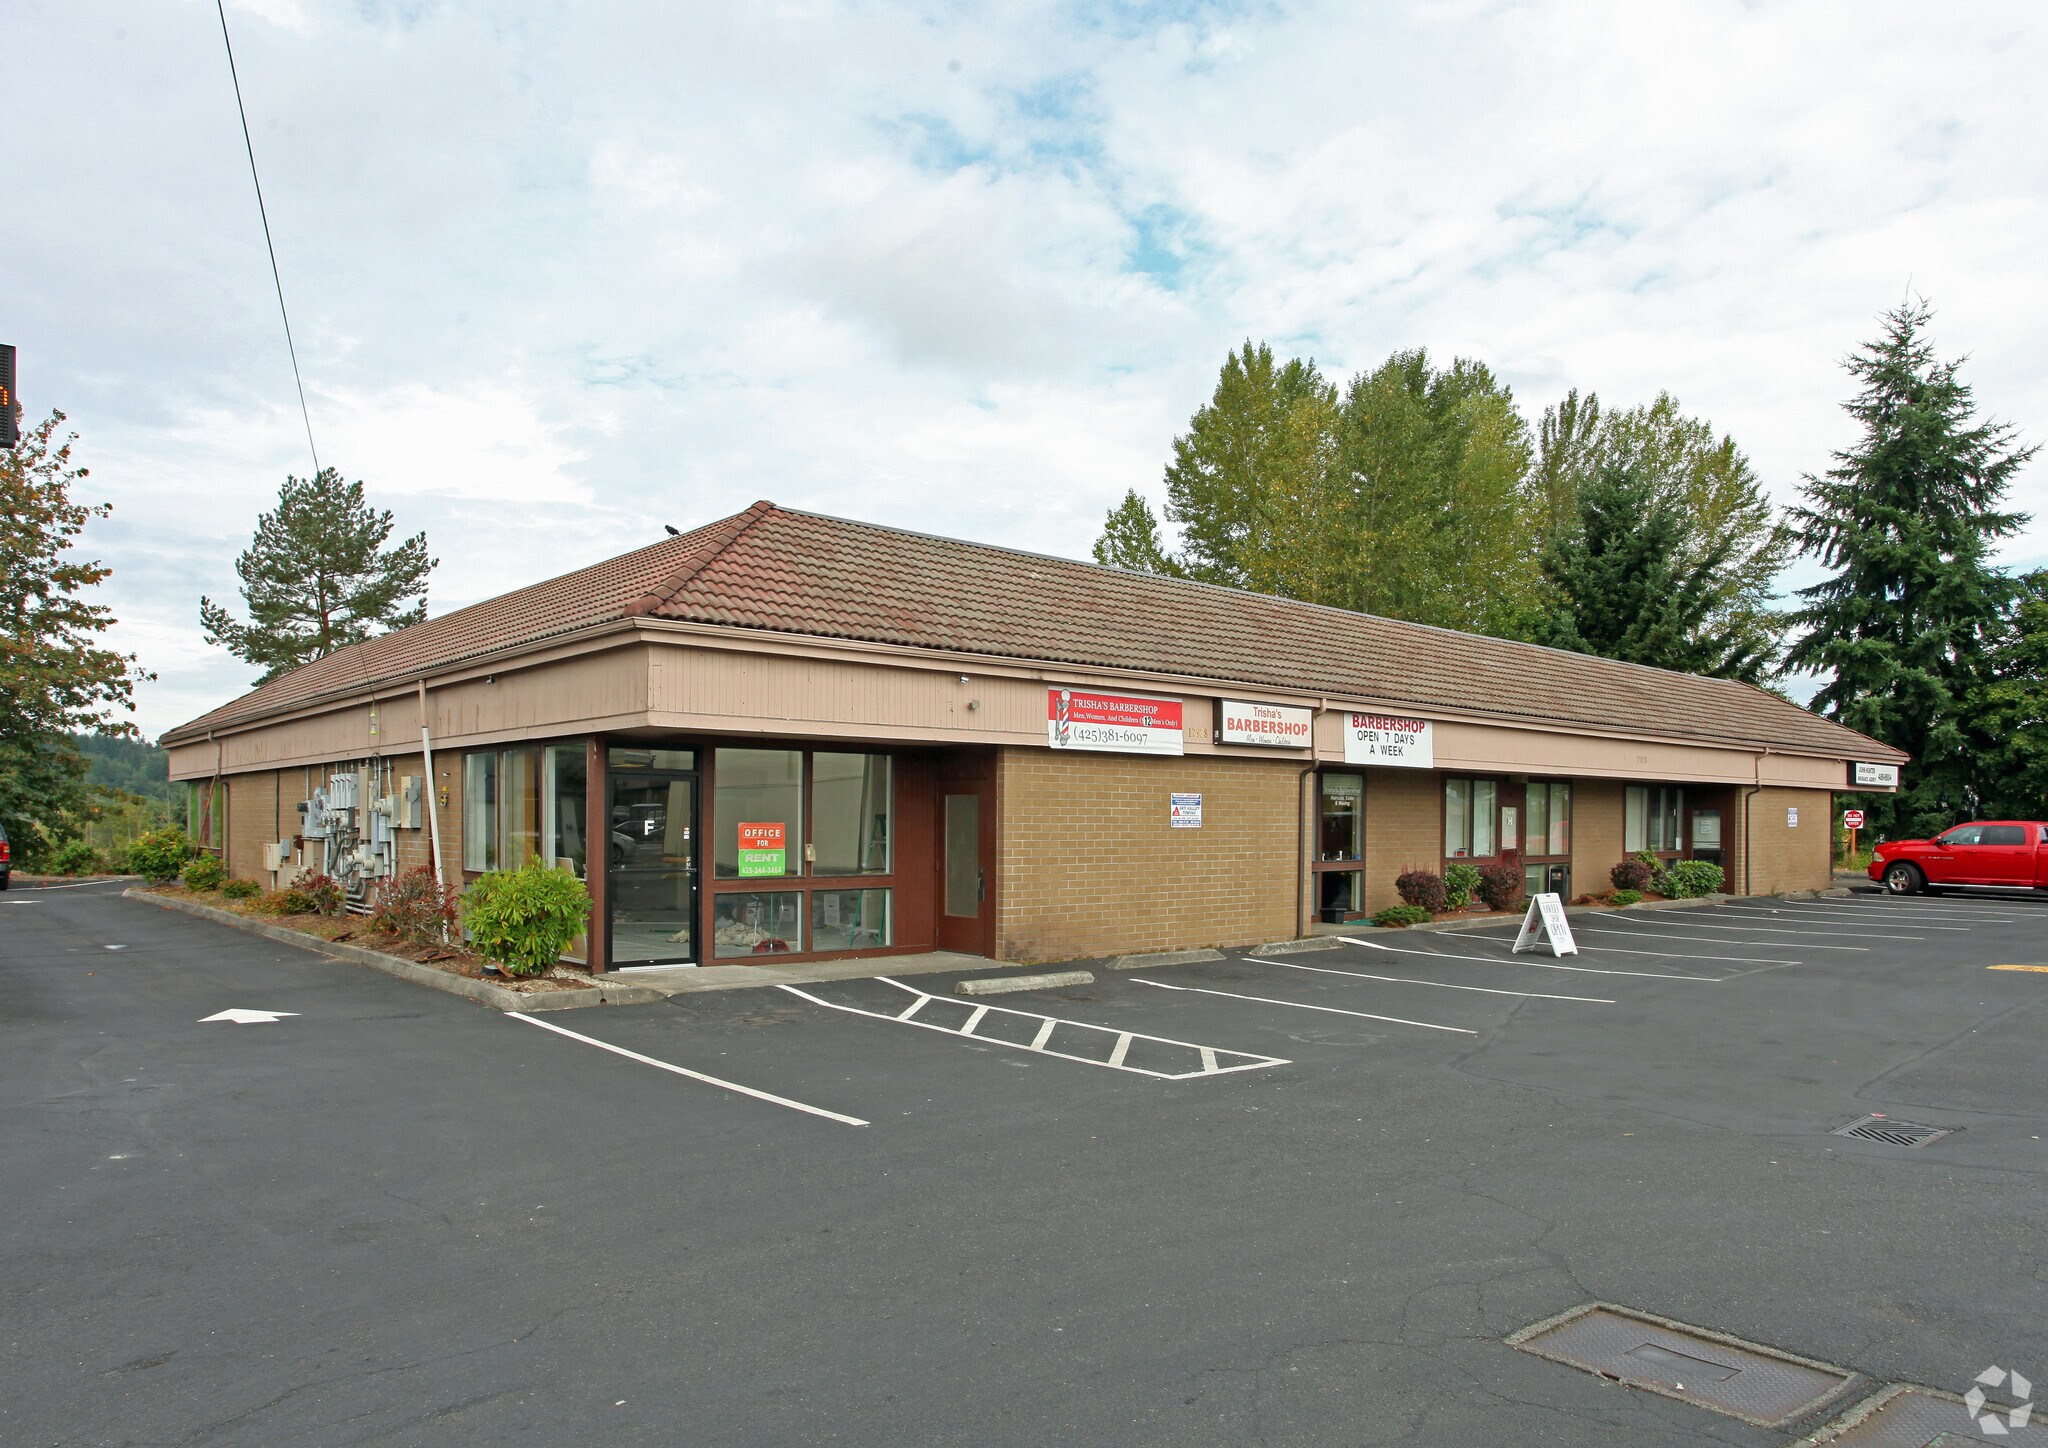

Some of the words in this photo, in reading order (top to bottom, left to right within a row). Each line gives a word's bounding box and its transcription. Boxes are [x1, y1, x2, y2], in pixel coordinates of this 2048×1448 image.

[1072, 698, 1108, 711] TRISHA'S
[1109, 702, 1159, 715] BARBERSHOP
[1253, 706, 1282, 719] Trisha's
[1107, 714, 1117, 722] And
[1118, 715, 1139, 724] Children
[1352, 713, 1425, 734] BARBERSHOP
[1227, 717, 1308, 736] BARBERSHOP
[1073, 725, 1148, 745] (425)381-6097
[1357, 730, 1379, 742] OPEN
[1384, 732, 1390, 743] 7
[1394, 733, 1415, 745] DAYS
[1369, 744, 1376, 755] A
[1380, 745, 1404, 757] WEEK
[644, 820, 655, 836] F
[744, 828, 781, 837] OFFICE
[756, 839, 769, 847] FOR
[745, 853, 780, 862] RENT
